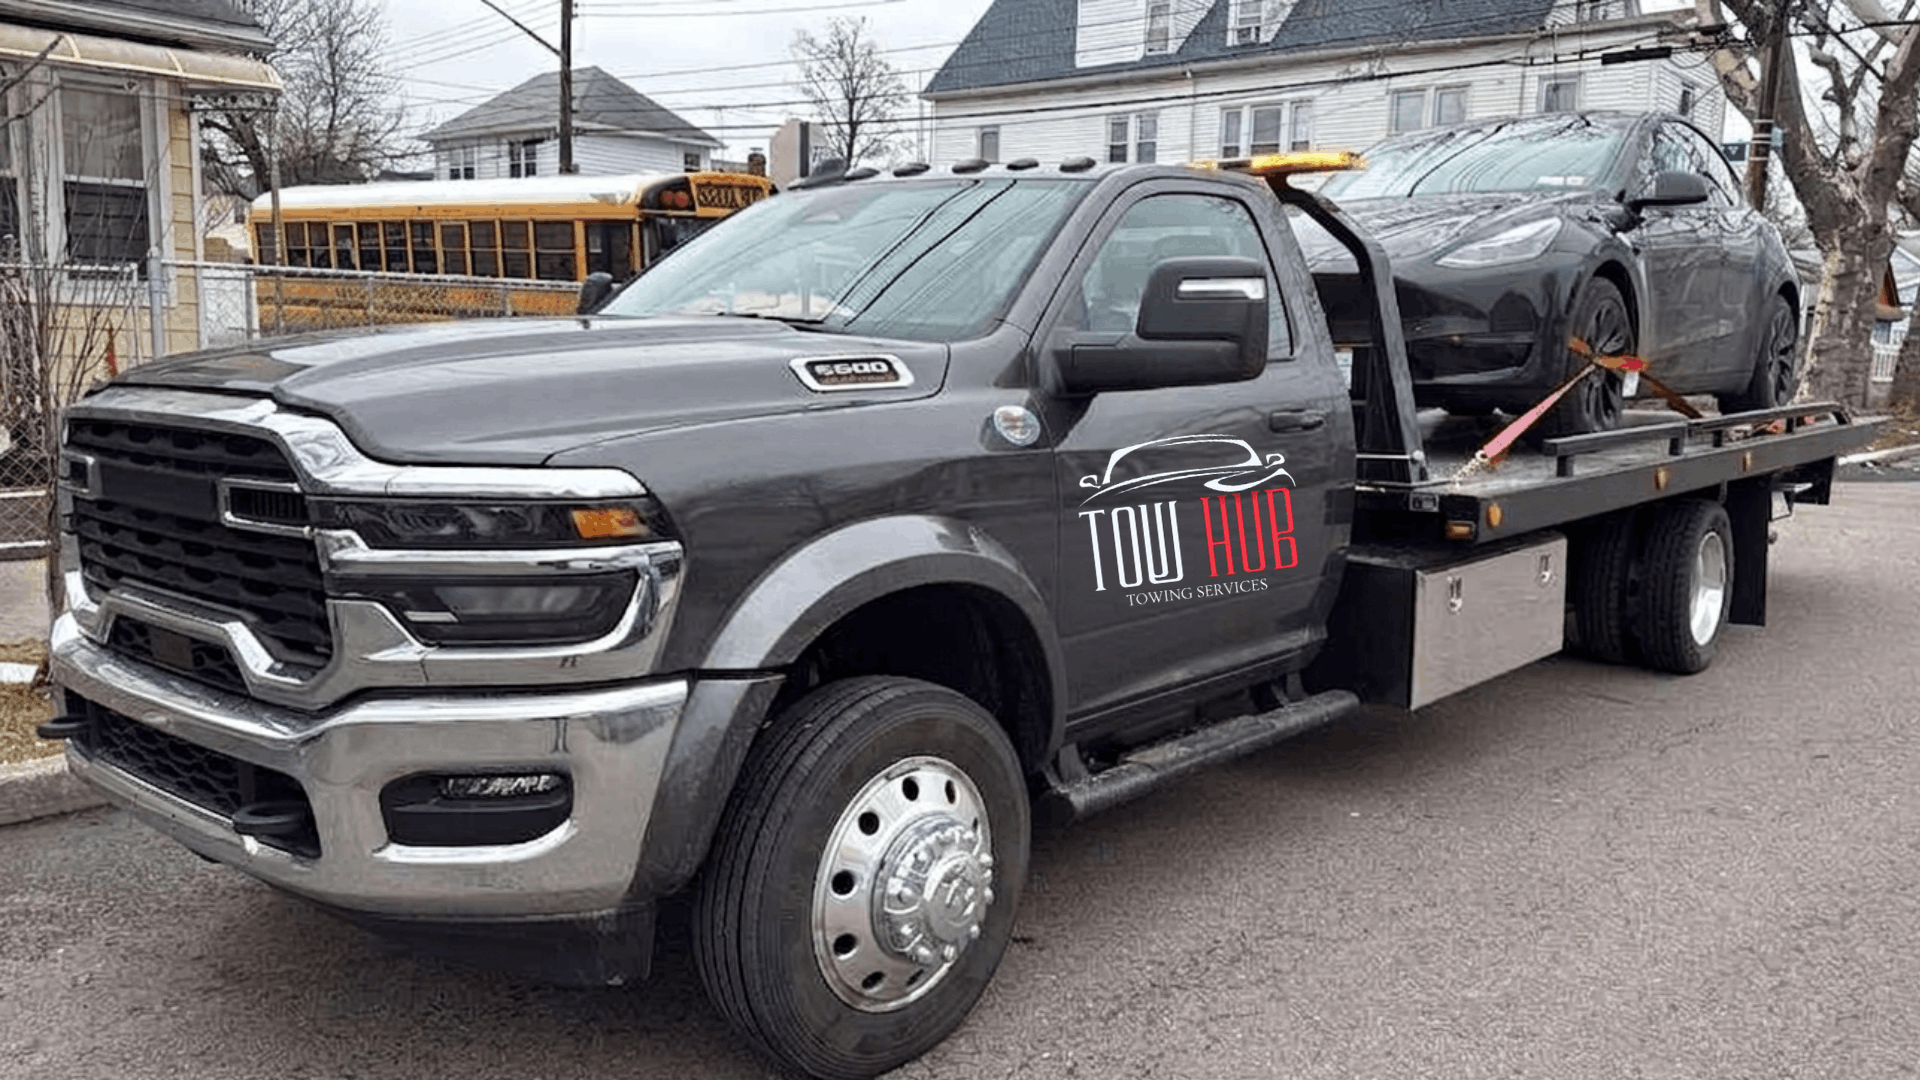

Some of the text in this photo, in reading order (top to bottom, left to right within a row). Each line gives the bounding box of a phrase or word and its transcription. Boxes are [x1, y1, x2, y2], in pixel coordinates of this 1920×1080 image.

[1078, 488, 1298, 592] TOW HUB
[1126, 578, 1269, 606] TOWING SERVICES
